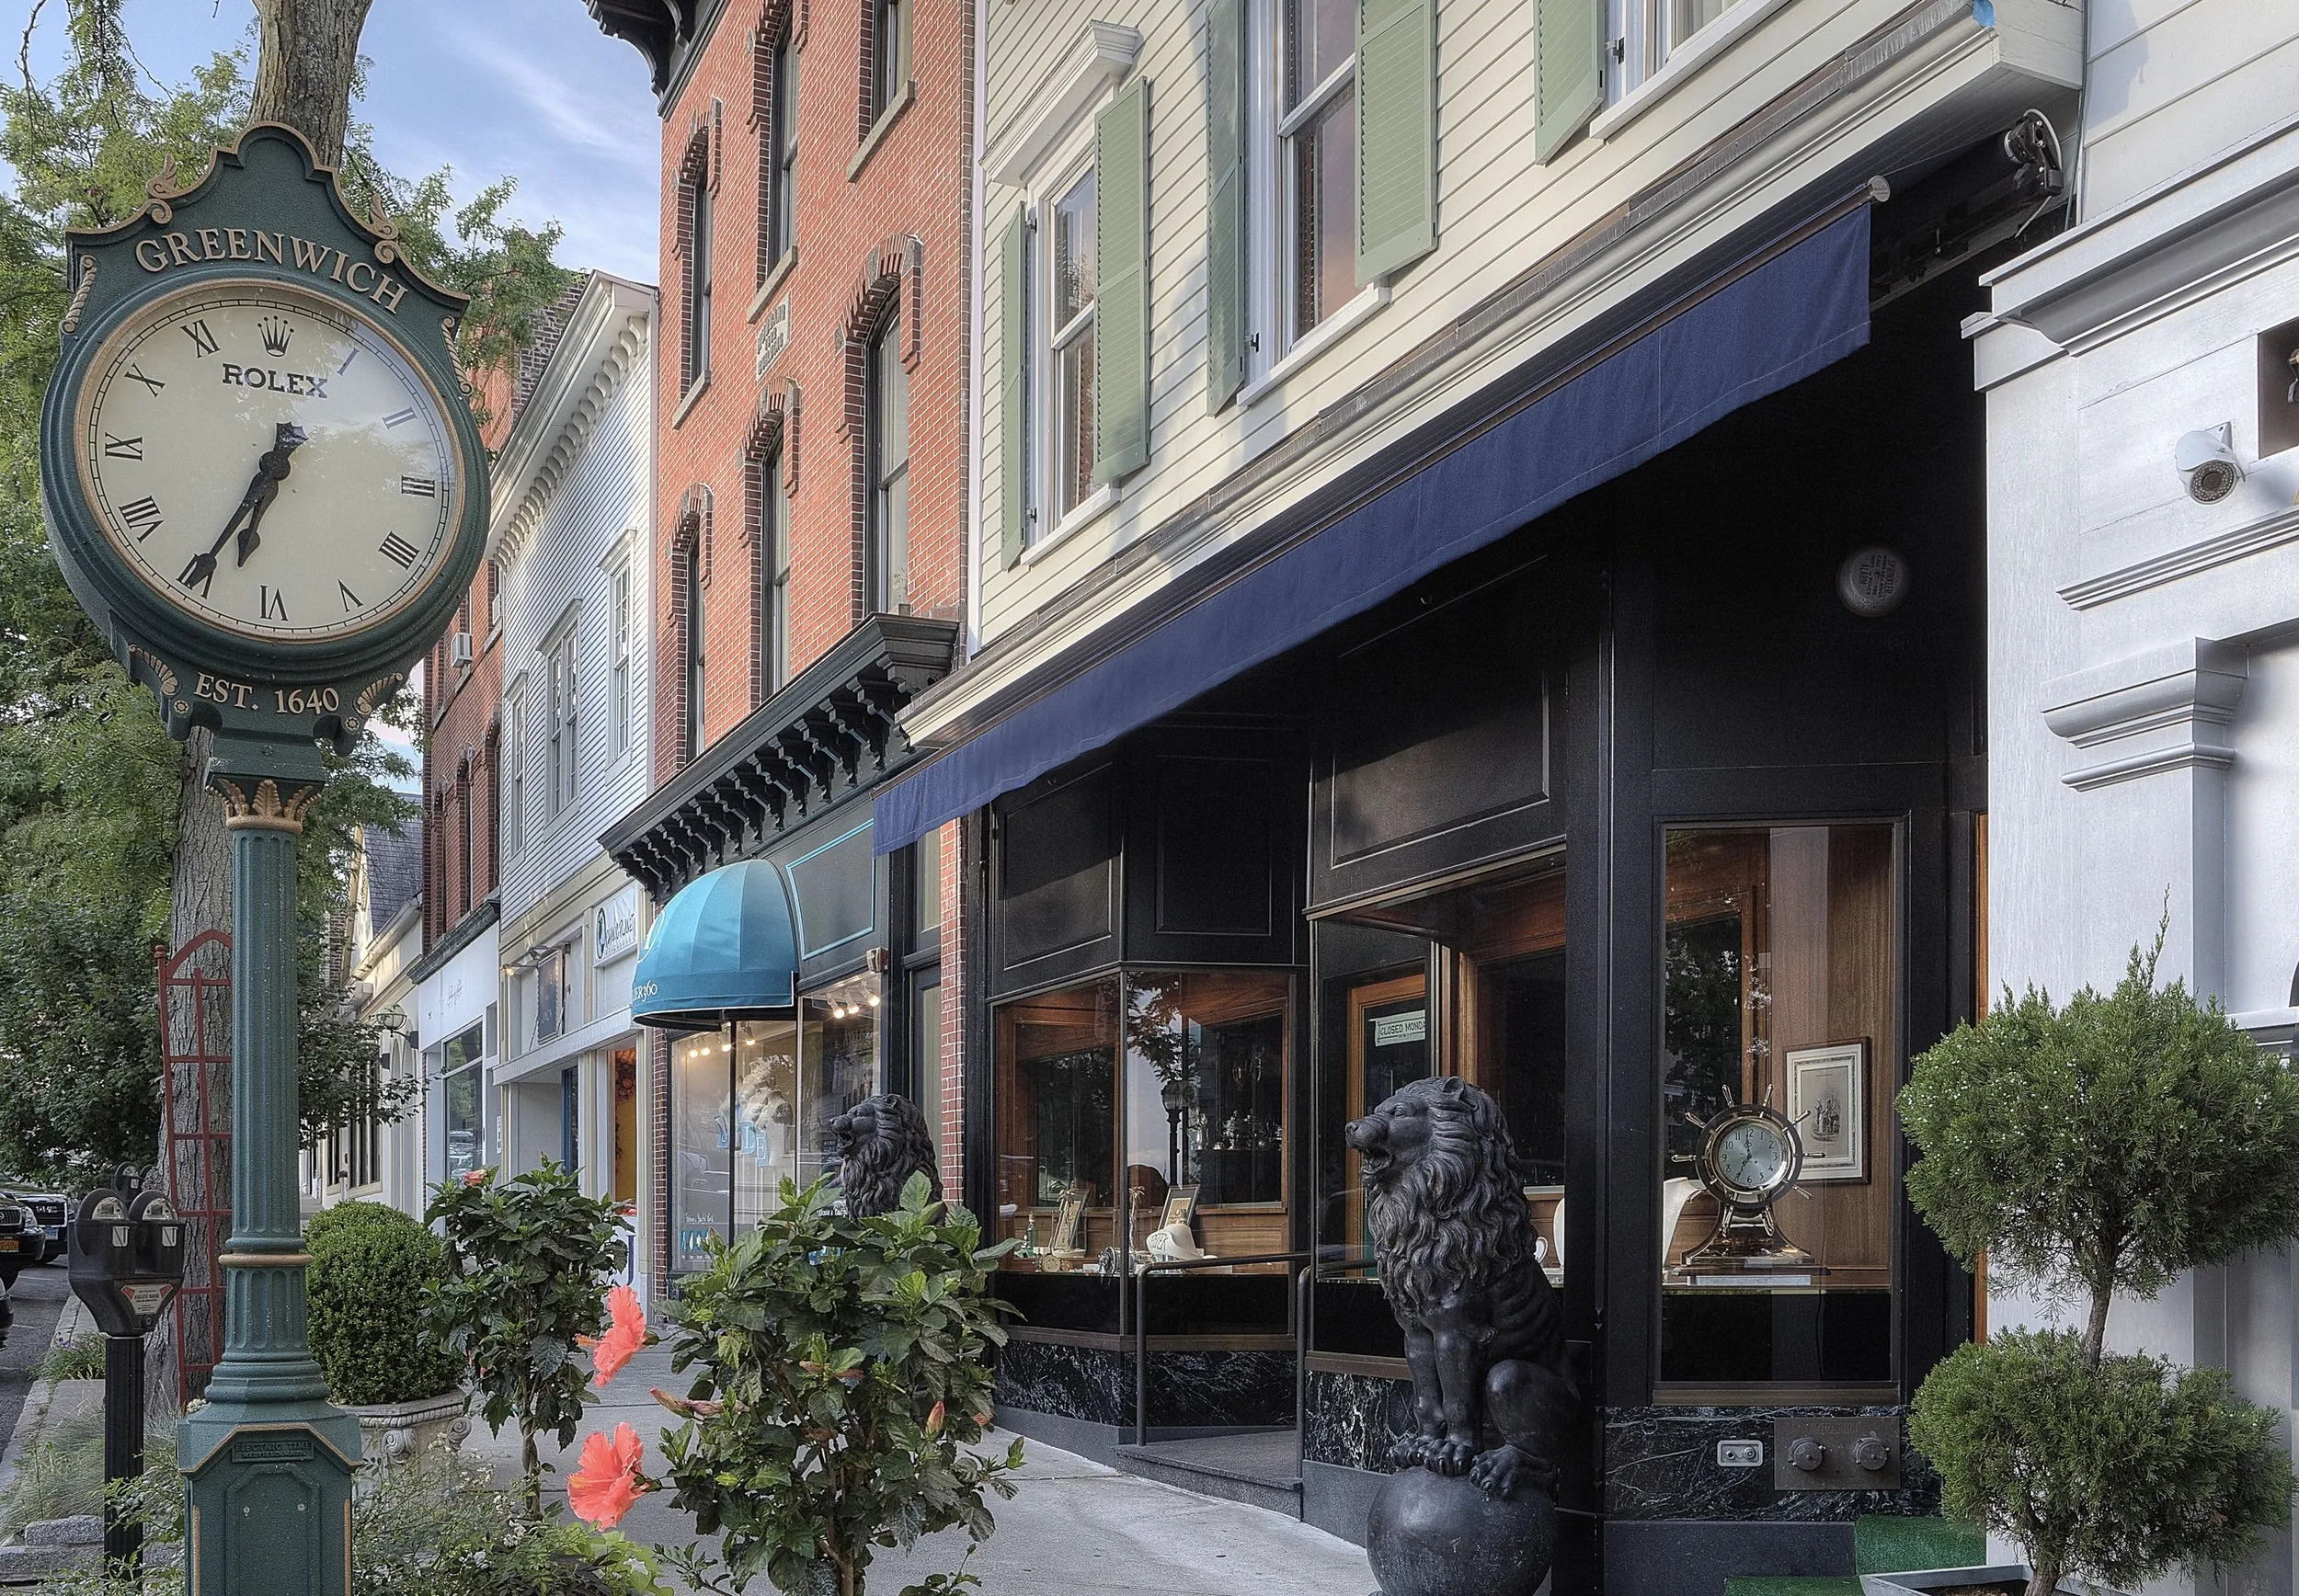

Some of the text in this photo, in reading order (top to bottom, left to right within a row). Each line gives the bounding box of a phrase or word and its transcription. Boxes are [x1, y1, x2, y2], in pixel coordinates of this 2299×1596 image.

[135, 228, 408, 314] GREENWICH
[179, 319, 222, 359] XI
[223, 364, 329, 399] ROLEX
[401, 474, 436, 498] III
[194, 672, 340, 715] EST. 1640
[1379, 1023, 1403, 1036] CLOSED
[234, 1441, 311, 1452] ELECTRIC TIME
